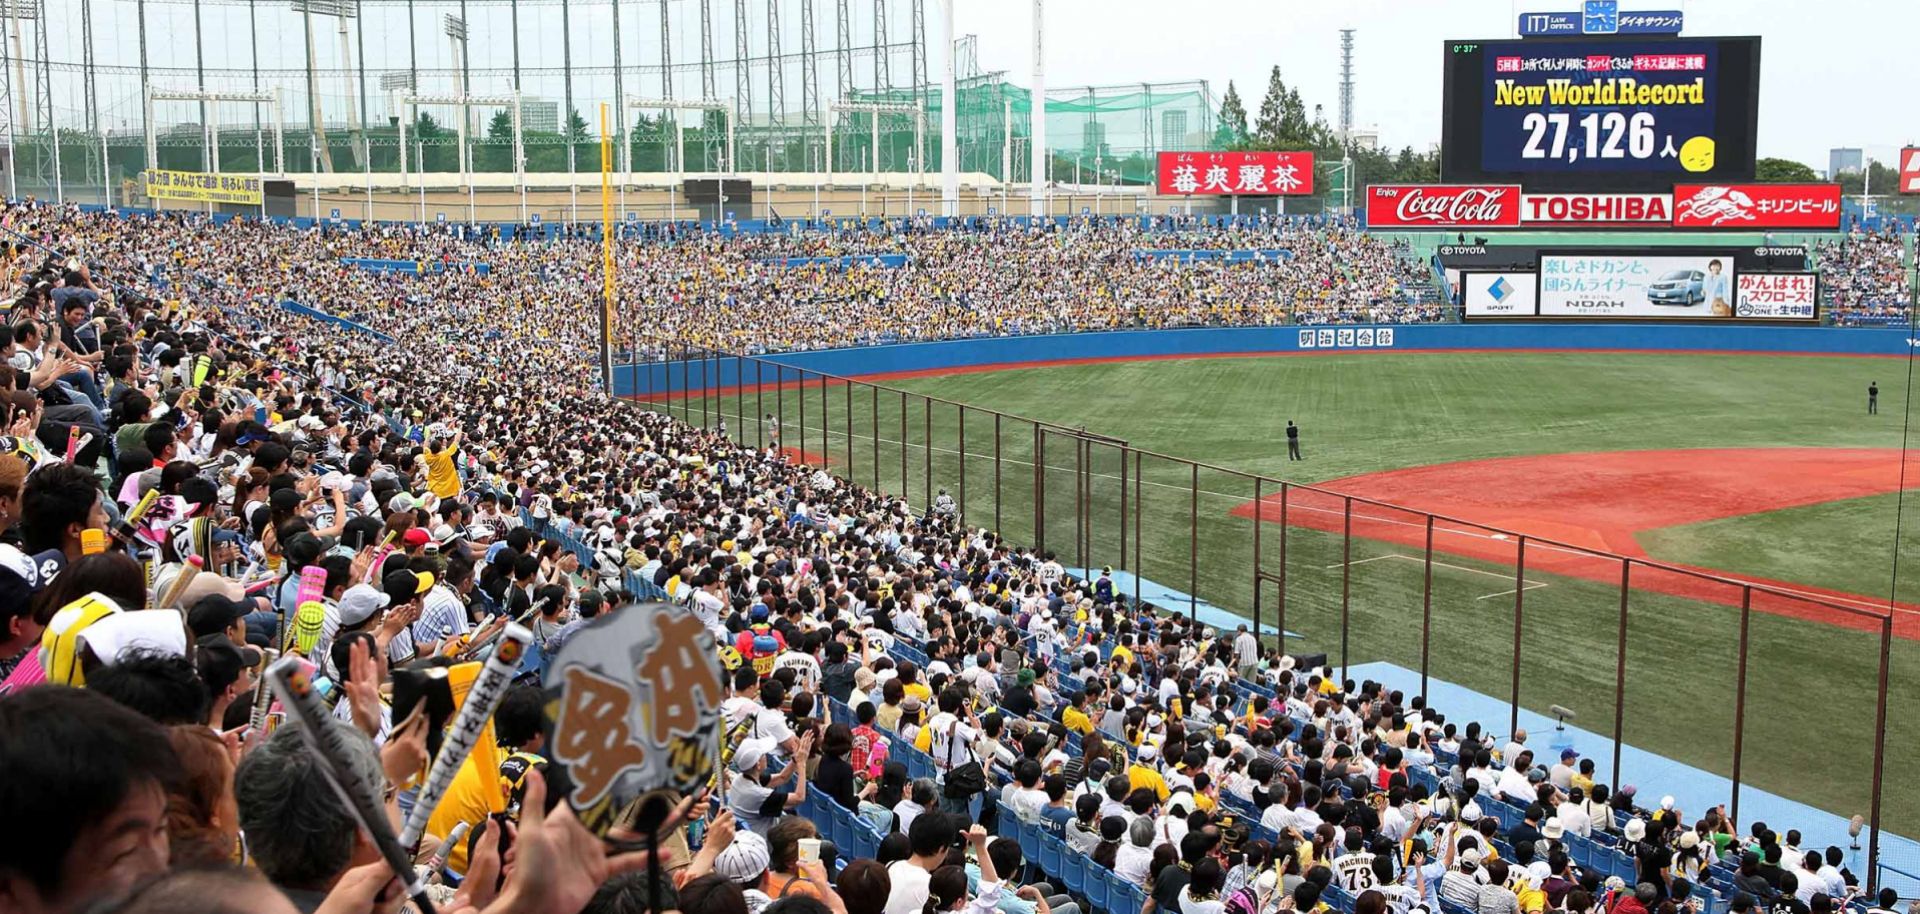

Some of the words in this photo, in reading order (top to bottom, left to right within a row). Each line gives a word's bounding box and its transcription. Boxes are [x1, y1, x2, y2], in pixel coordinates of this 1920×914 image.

[1528, 15, 1550, 32] ITJ
[1618, 16, 1682, 27] ダイキサウンド
[1495, 80, 1546, 106] New
[1546, 78, 1618, 105] World
[1619, 77, 1704, 104] Record
[1522, 112, 1655, 163] 27,126
[1376, 188, 1398, 197] Enjoy
[1397, 188, 1507, 221] Coca-Cola
[1528, 197, 1666, 220] TOSHIBA
[1757, 198, 1838, 214] キリンビール
[1454, 246, 1486, 254] TOYOTA
[1566, 300, 1625, 308] NOAH
[1338, 857, 1373, 870] MACHID
[1344, 866, 1373, 891] 73
